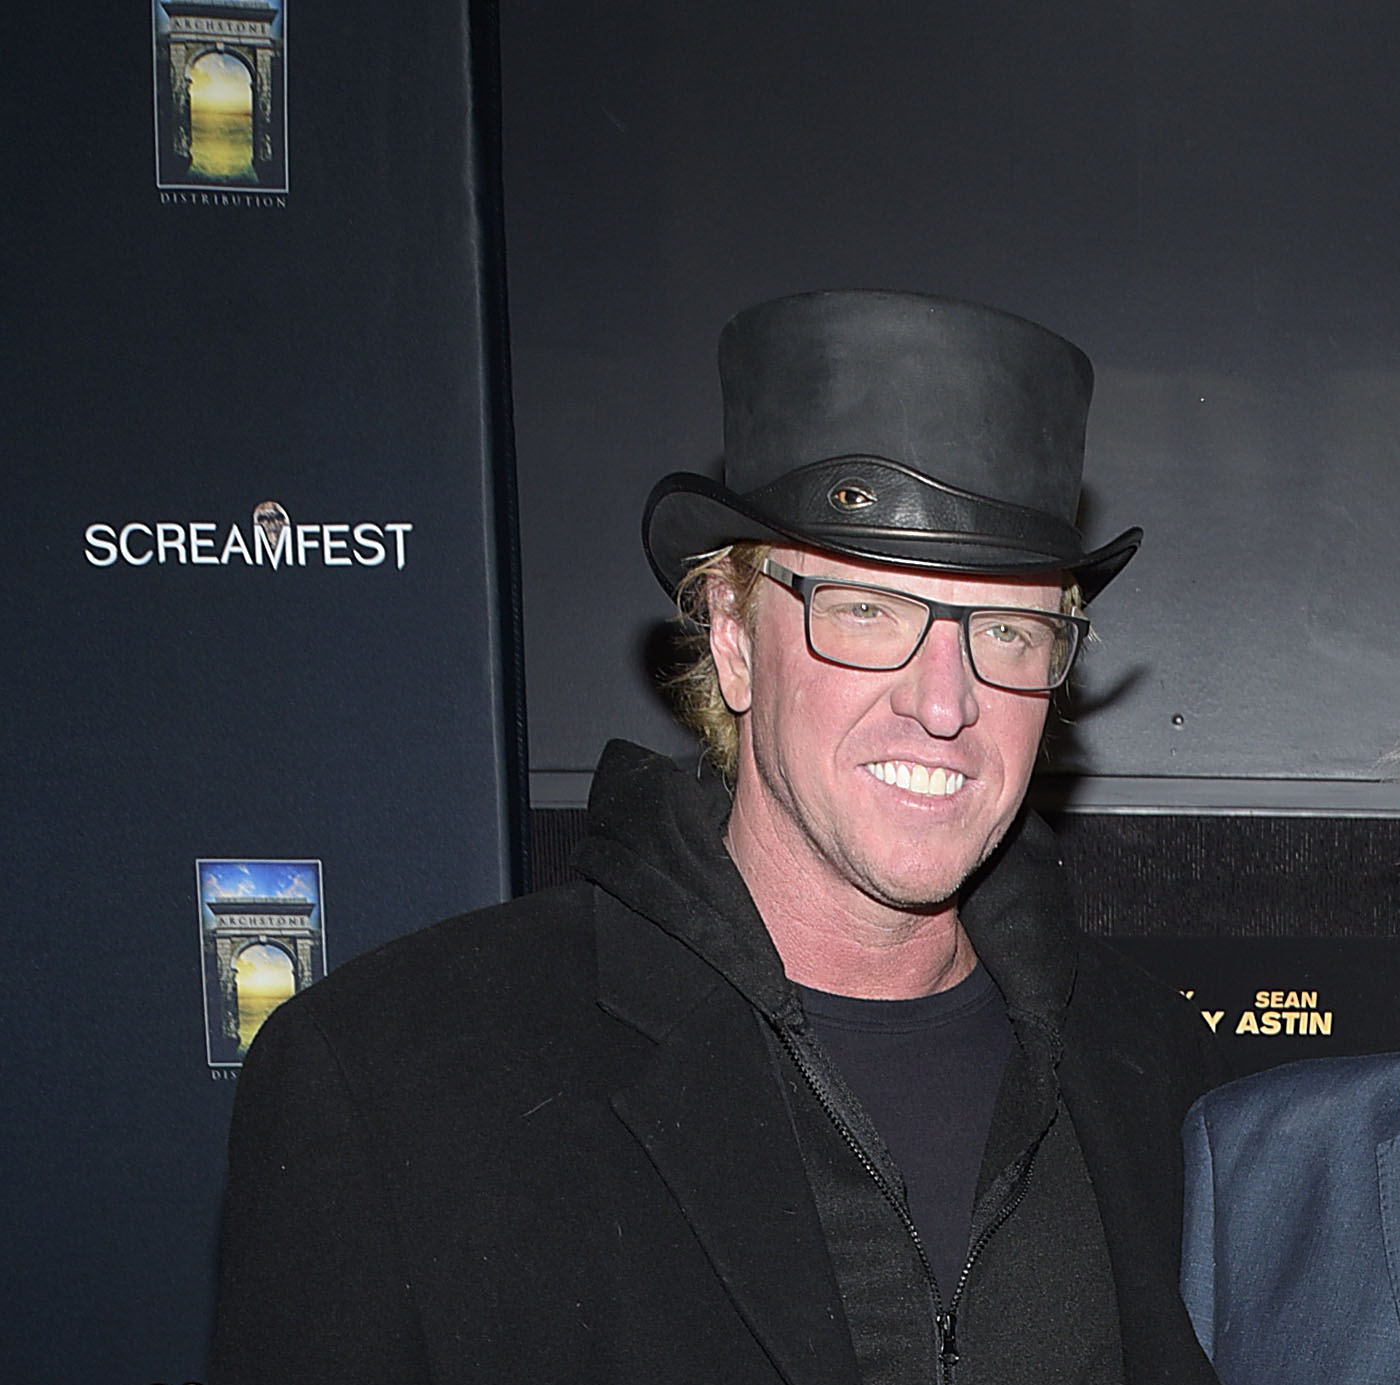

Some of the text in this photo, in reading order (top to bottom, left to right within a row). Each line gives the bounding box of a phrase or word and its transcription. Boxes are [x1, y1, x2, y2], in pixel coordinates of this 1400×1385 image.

[160, 191, 287, 209] DISTRIBUTION
[84, 520, 413, 571] SCREAMFEST
[218, 915, 306, 928] ARCHSTONE
[1254, 991, 1318, 1008] SEAN
[1235, 1011, 1333, 1035] ASTIN
